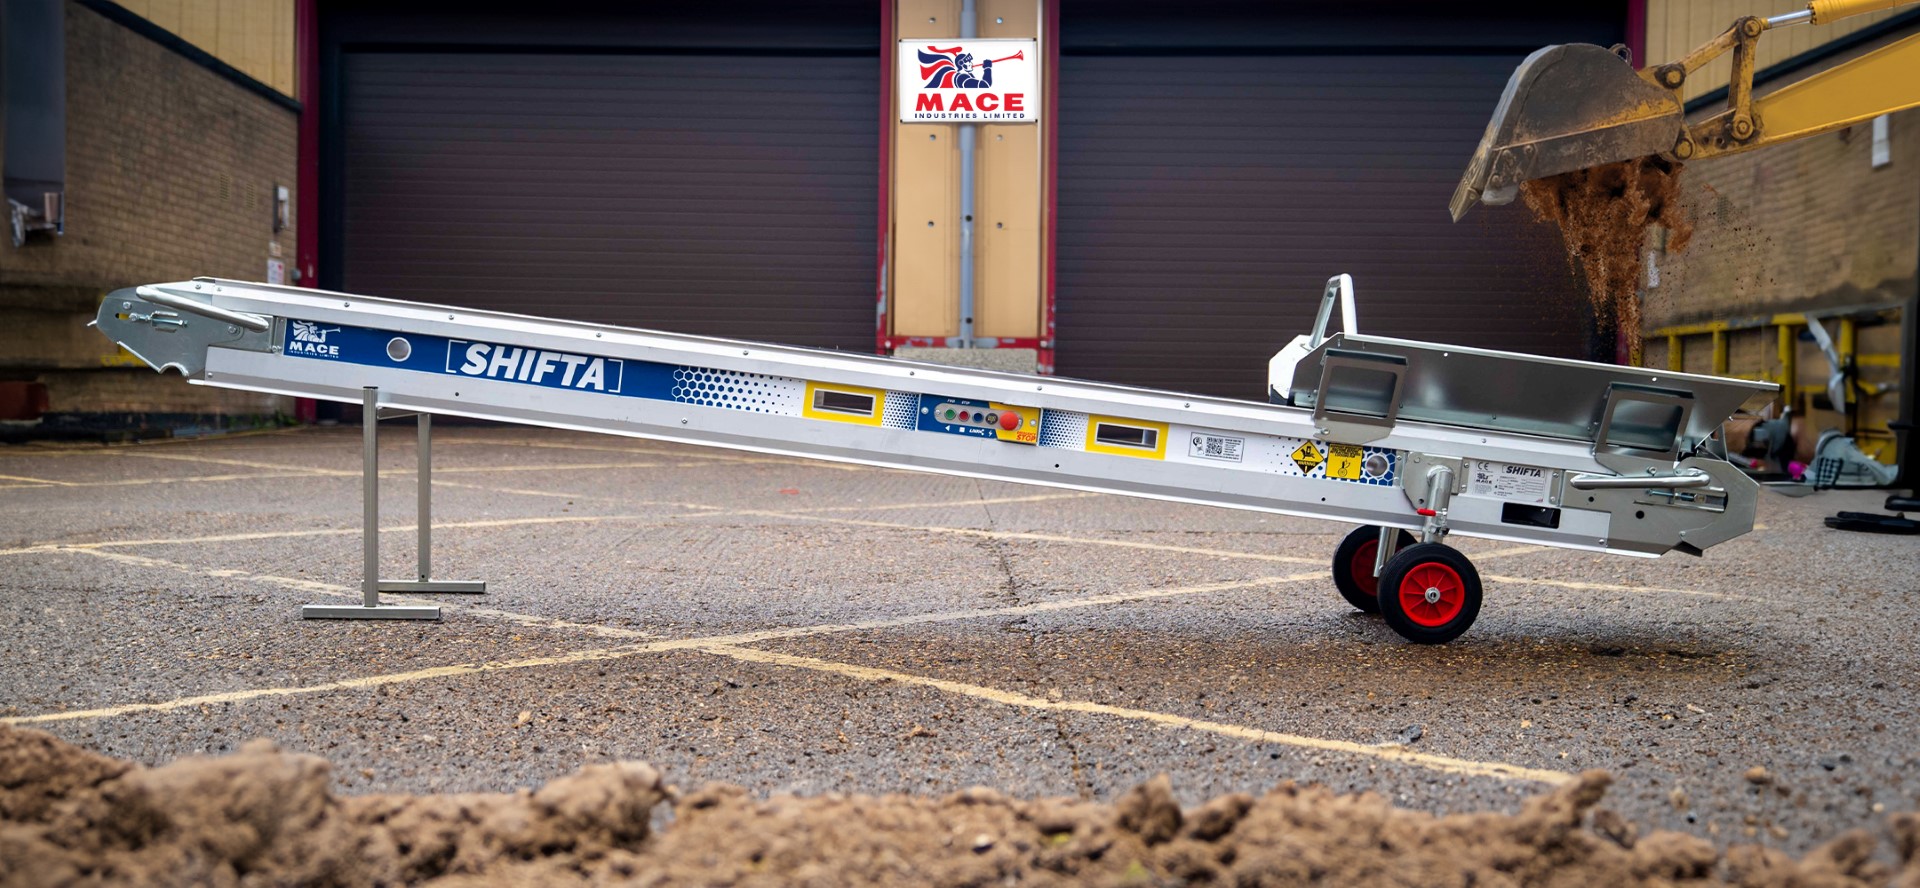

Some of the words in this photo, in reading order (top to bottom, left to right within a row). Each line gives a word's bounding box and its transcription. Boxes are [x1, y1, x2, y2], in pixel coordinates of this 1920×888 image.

[915, 93, 1024, 111] MACE
[289, 341, 339, 355] MACE
[460, 343, 604, 391] SHIFTA
[1016, 434, 1036, 442] STOP
[1506, 465, 1541, 478] SHIFTA
